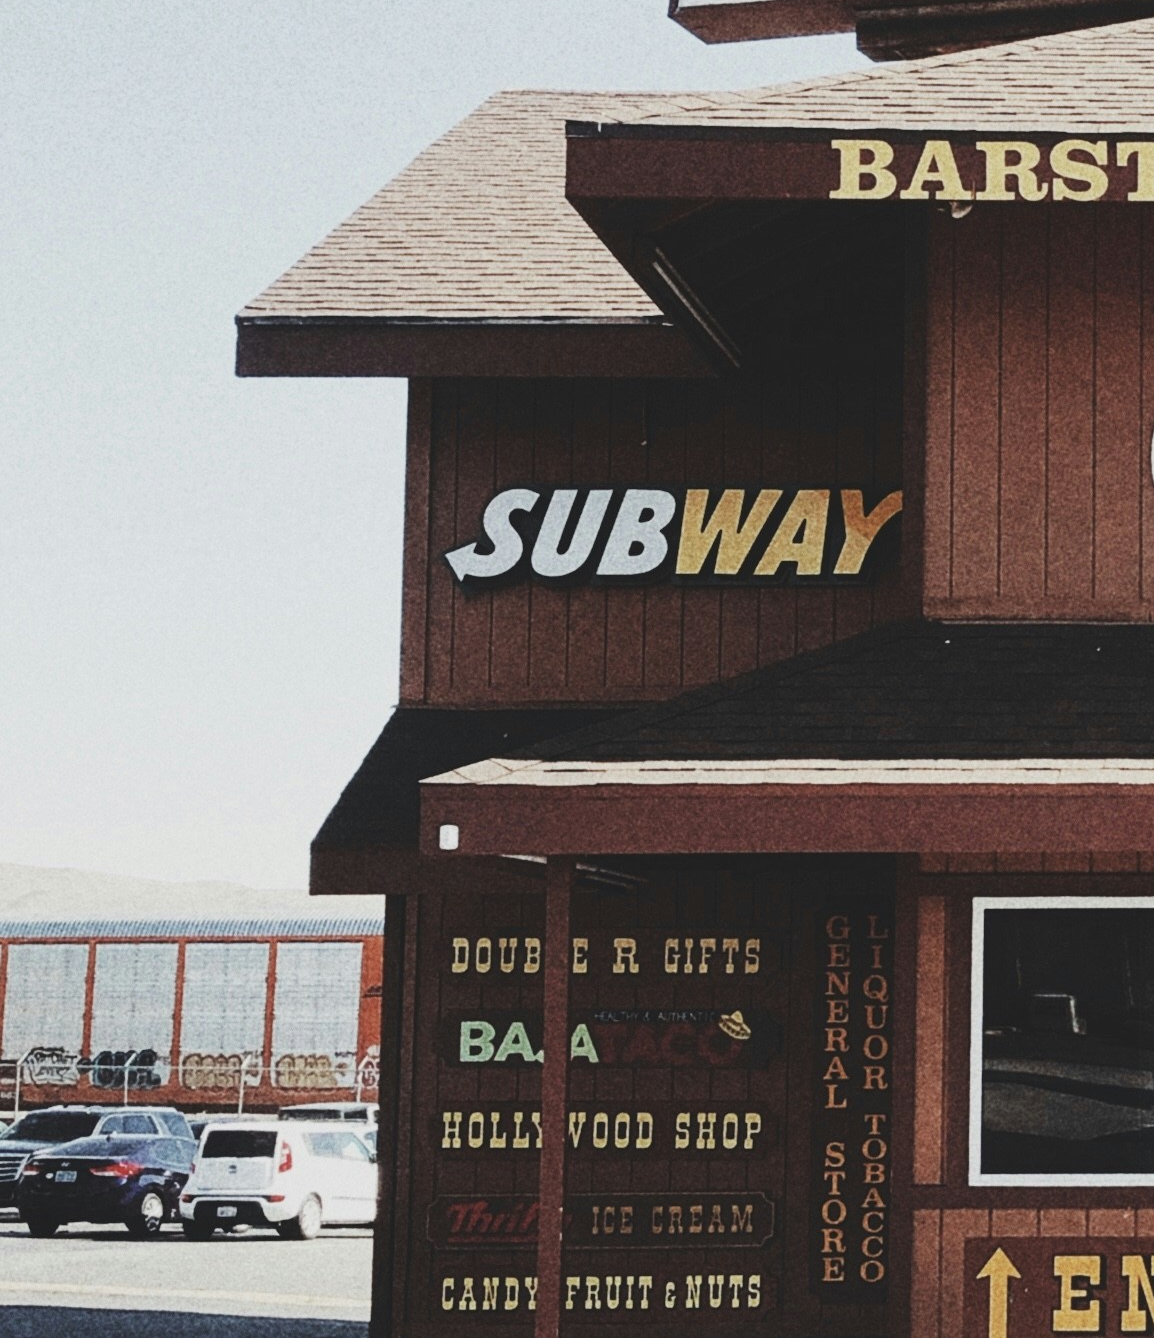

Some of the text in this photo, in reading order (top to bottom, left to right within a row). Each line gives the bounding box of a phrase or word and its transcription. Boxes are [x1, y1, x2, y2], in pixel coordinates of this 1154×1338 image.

[445, 488, 904, 582] SUBWAY
[451, 938, 761, 974] DOUBE R GIFTS
[459, 1021, 744, 1064] BAA TACO
[820, 915, 851, 1283] GENERAL STORE
[860, 915, 890, 1283] LIQUOR TOBACCO
[441, 1112, 763, 1149] HOLLYWOOD SHOP
[592, 1205, 634, 1235] ICE
[651, 1204, 755, 1235] CREAM
[441, 1274, 763, 1311] CANDY FRUIT & NUTS
